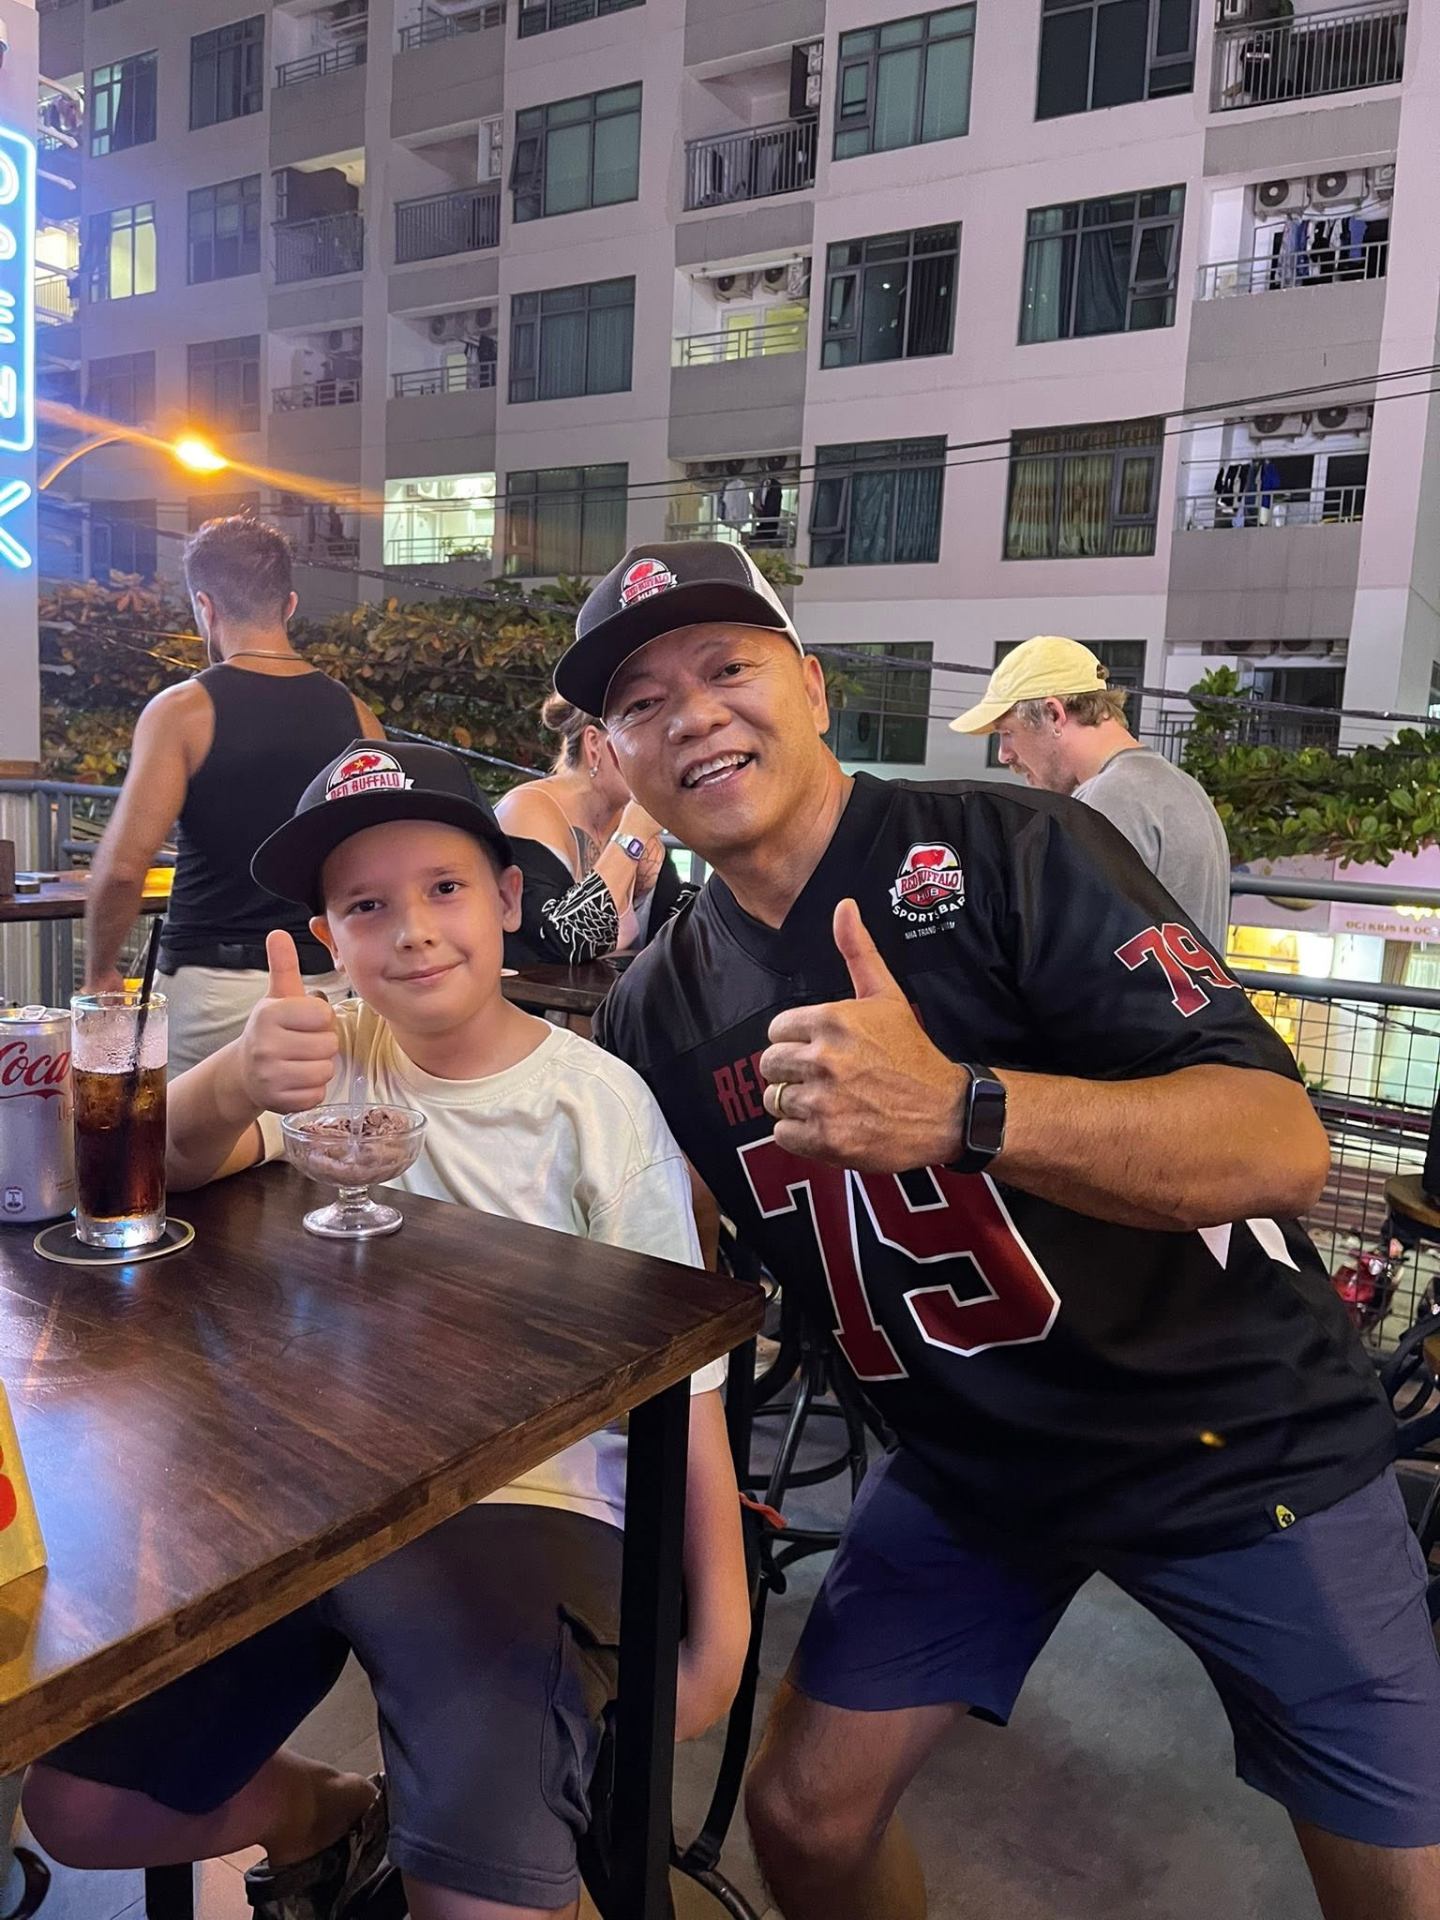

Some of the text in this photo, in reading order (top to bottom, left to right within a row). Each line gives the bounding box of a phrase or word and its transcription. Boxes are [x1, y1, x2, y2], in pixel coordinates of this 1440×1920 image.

[351, 773, 400, 792] BUFFALO
[901, 868, 959, 893] RED BUFFALO
[1114, 923, 1243, 1018] 79
[737, 1134, 1062, 1381] 79
